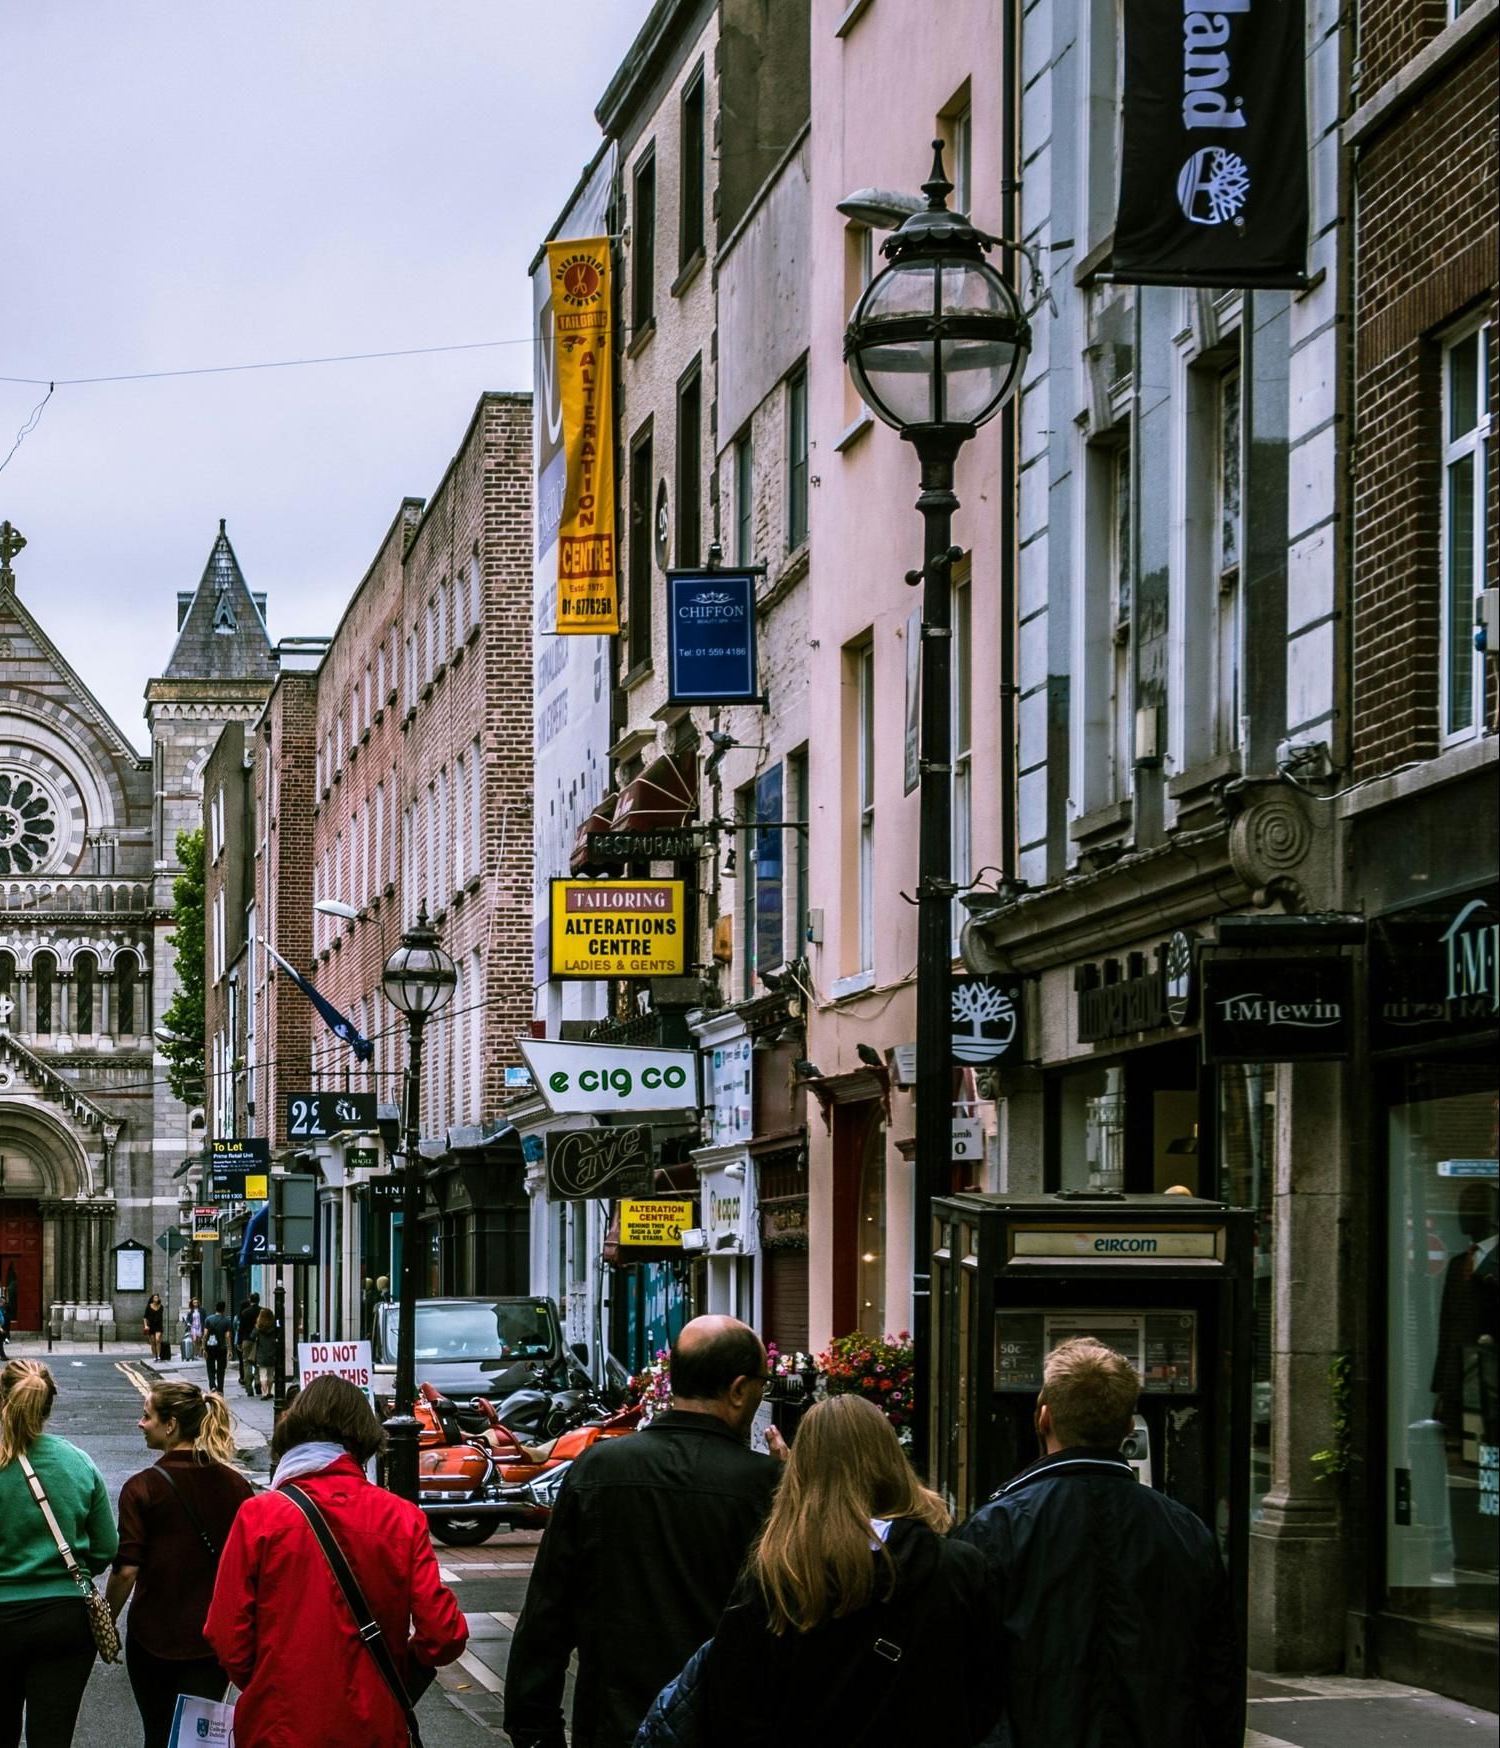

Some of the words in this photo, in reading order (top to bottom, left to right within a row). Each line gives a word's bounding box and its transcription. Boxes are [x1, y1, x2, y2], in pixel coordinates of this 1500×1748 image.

[577, 351, 597, 529] ALTERATION
[562, 539, 612, 574] CENTRE
[679, 605, 744, 618] CHIFFON
[679, 648, 694, 657] Tel:
[696, 648, 706, 657] 01
[725, 647, 746, 656] 4186
[593, 835, 693, 856] RESTAURANT
[574, 892, 666, 908] TAILORING
[565, 918, 677, 935] ALTERATIONS
[588, 939, 652, 955] CENTRE
[565, 960, 612, 971] LADIES
[616, 960, 625, 970] &
[630, 960, 676, 971] GENTS
[549, 1071, 570, 1093] e
[641, 1065, 687, 1089] co
[213, 1142, 225, 1152] To
[227, 1142, 243, 1151] Let
[628, 1205, 685, 1214] ALTERATION
[639, 1213, 675, 1222] CENTRE
[311, 1346, 329, 1363] DO
[332, 1345, 358, 1362] NOT
[339, 1368, 369, 1386] THIS
